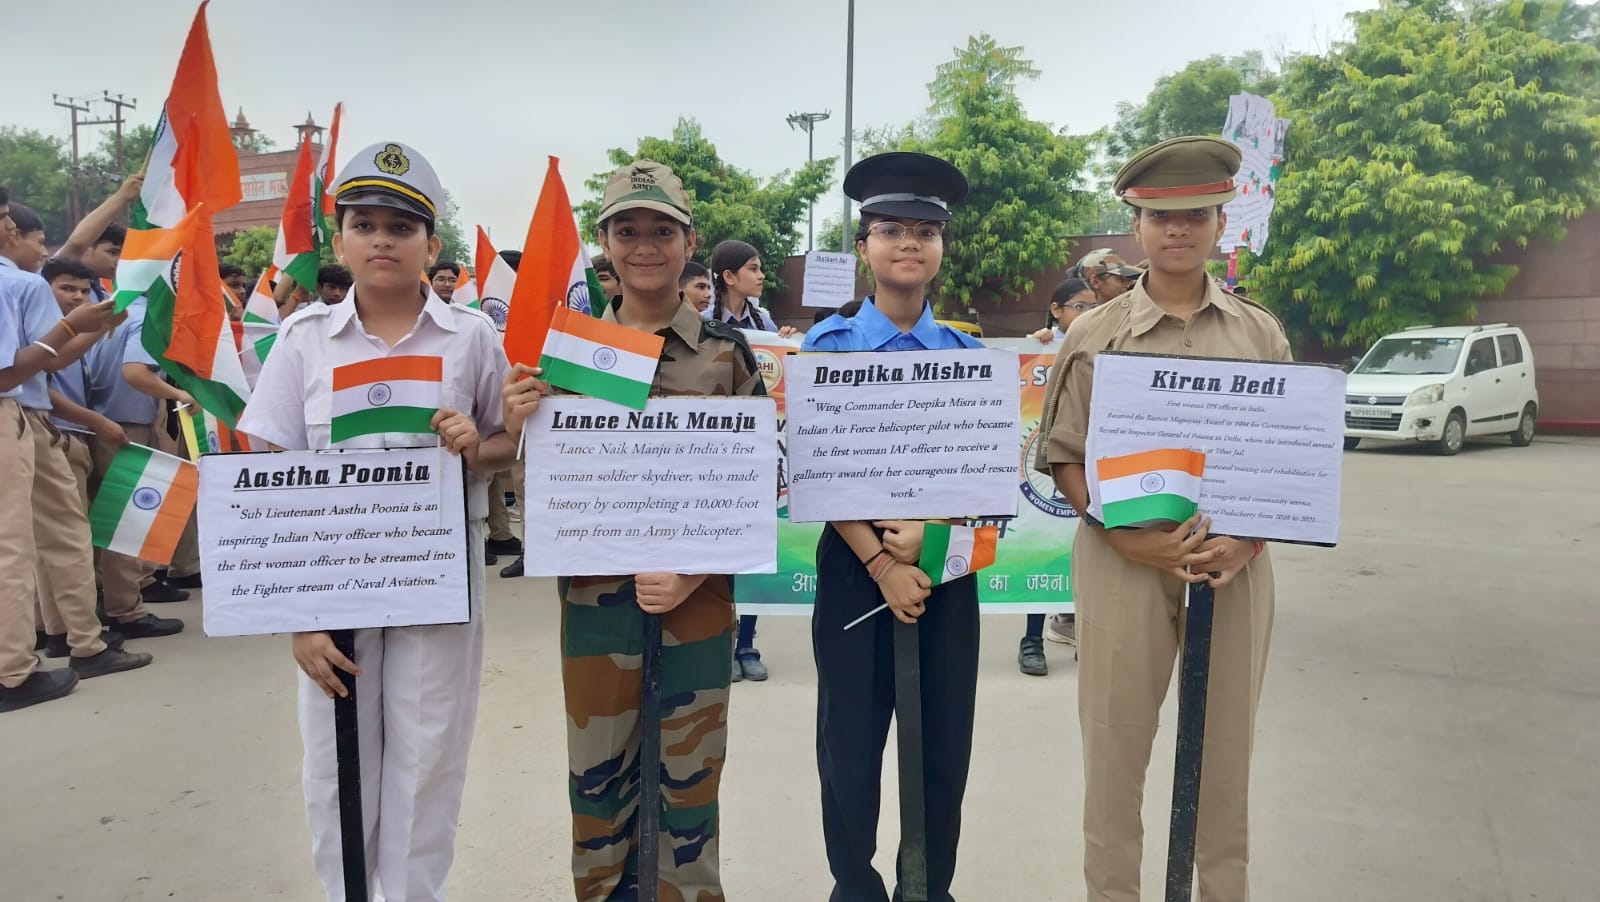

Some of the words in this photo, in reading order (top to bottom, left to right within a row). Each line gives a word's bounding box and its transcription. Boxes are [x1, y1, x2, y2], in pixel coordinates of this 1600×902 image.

[631, 176, 655, 184] INDIAN
[814, 365, 904, 386] Deepika
[912, 362, 992, 381] Mishra
[1151, 370, 1221, 391] Kiran
[1229, 374, 1286, 396] Bedi
[844, 401, 904, 411] Commander
[907, 399, 946, 410] Deepika
[949, 398, 976, 407] Misra
[979, 397, 987, 406] is
[990, 398, 1002, 406] an
[552, 411, 619, 429] Lance
[626, 411, 678, 429] Naik
[686, 411, 756, 433] Manju
[798, 426, 827, 435] Indian
[831, 425, 846, 434] Air
[850, 424, 875, 433] Force
[878, 422, 924, 433] helicopter
[927, 421, 950, 432] pilot
[954, 421, 973, 430] who
[976, 420, 1013, 429] became
[1203, 415, 1224, 426] Award
[1250, 420, 1260, 428] for
[1261, 420, 1301, 431] Government
[600, 443, 627, 454] Naik
[632, 443, 670, 457] Manju
[676, 444, 684, 454] is
[732, 443, 754, 454] first
[812, 447, 827, 457] the
[831, 446, 849, 456] first
[852, 447, 886, 455] woman
[890, 445, 909, 454] IAF
[911, 444, 941, 454] officer
[944, 444, 953, 452] to
[957, 442, 989, 451] receive
[1277, 439, 1312, 447] introduced
[235, 465, 330, 489] Aastha
[339, 462, 430, 485] Poonia
[550, 472, 592, 481] woman
[597, 470, 638, 481] soldier
[641, 470, 693, 485] skydiver,
[698, 471, 722, 481] who
[727, 470, 759, 481] made
[793, 470, 835, 483] gallantry
[838, 469, 866, 479] award
[869, 467, 884, 478] for
[886, 467, 902, 477] her
[905, 468, 957, 478] courageous
[960, 464, 1017, 474] flood-rescue
[266, 507, 325, 519] Lieutenant
[329, 505, 367, 515] Aastha
[372, 503, 409, 513] Poonia
[413, 502, 422, 511] is
[548, 498, 590, 513] history
[594, 498, 607, 513] by
[612, 498, 678, 512] completing
[683, 500, 689, 509] a
[694, 497, 759, 510] 10,000-foot
[1028, 493, 1055, 513] WOMEN
[218, 534, 268, 548] inspiring
[272, 532, 308, 543] Indian
[313, 531, 343, 544] Navy
[346, 528, 380, 540] officer
[385, 528, 408, 537] who
[412, 526, 452, 537] became
[555, 527, 588, 541] jump
[592, 525, 621, 537] from
[626, 528, 640, 537] an
[643, 526, 679, 540] Army
[218, 560, 235, 571] the
[239, 559, 261, 570] first
[266, 559, 306, 568] woman
[310, 555, 346, 566] officer
[349, 555, 359, 564] to
[364, 553, 377, 564] be
[380, 551, 430, 563] streamed
[434, 550, 455, 560] into
[231, 585, 249, 596] the
[253, 583, 293, 597] Fighter
[297, 582, 333, 592] stream
[338, 578, 352, 590] of
[353, 577, 385, 590] Naval
[988, 574, 1010, 592] का
